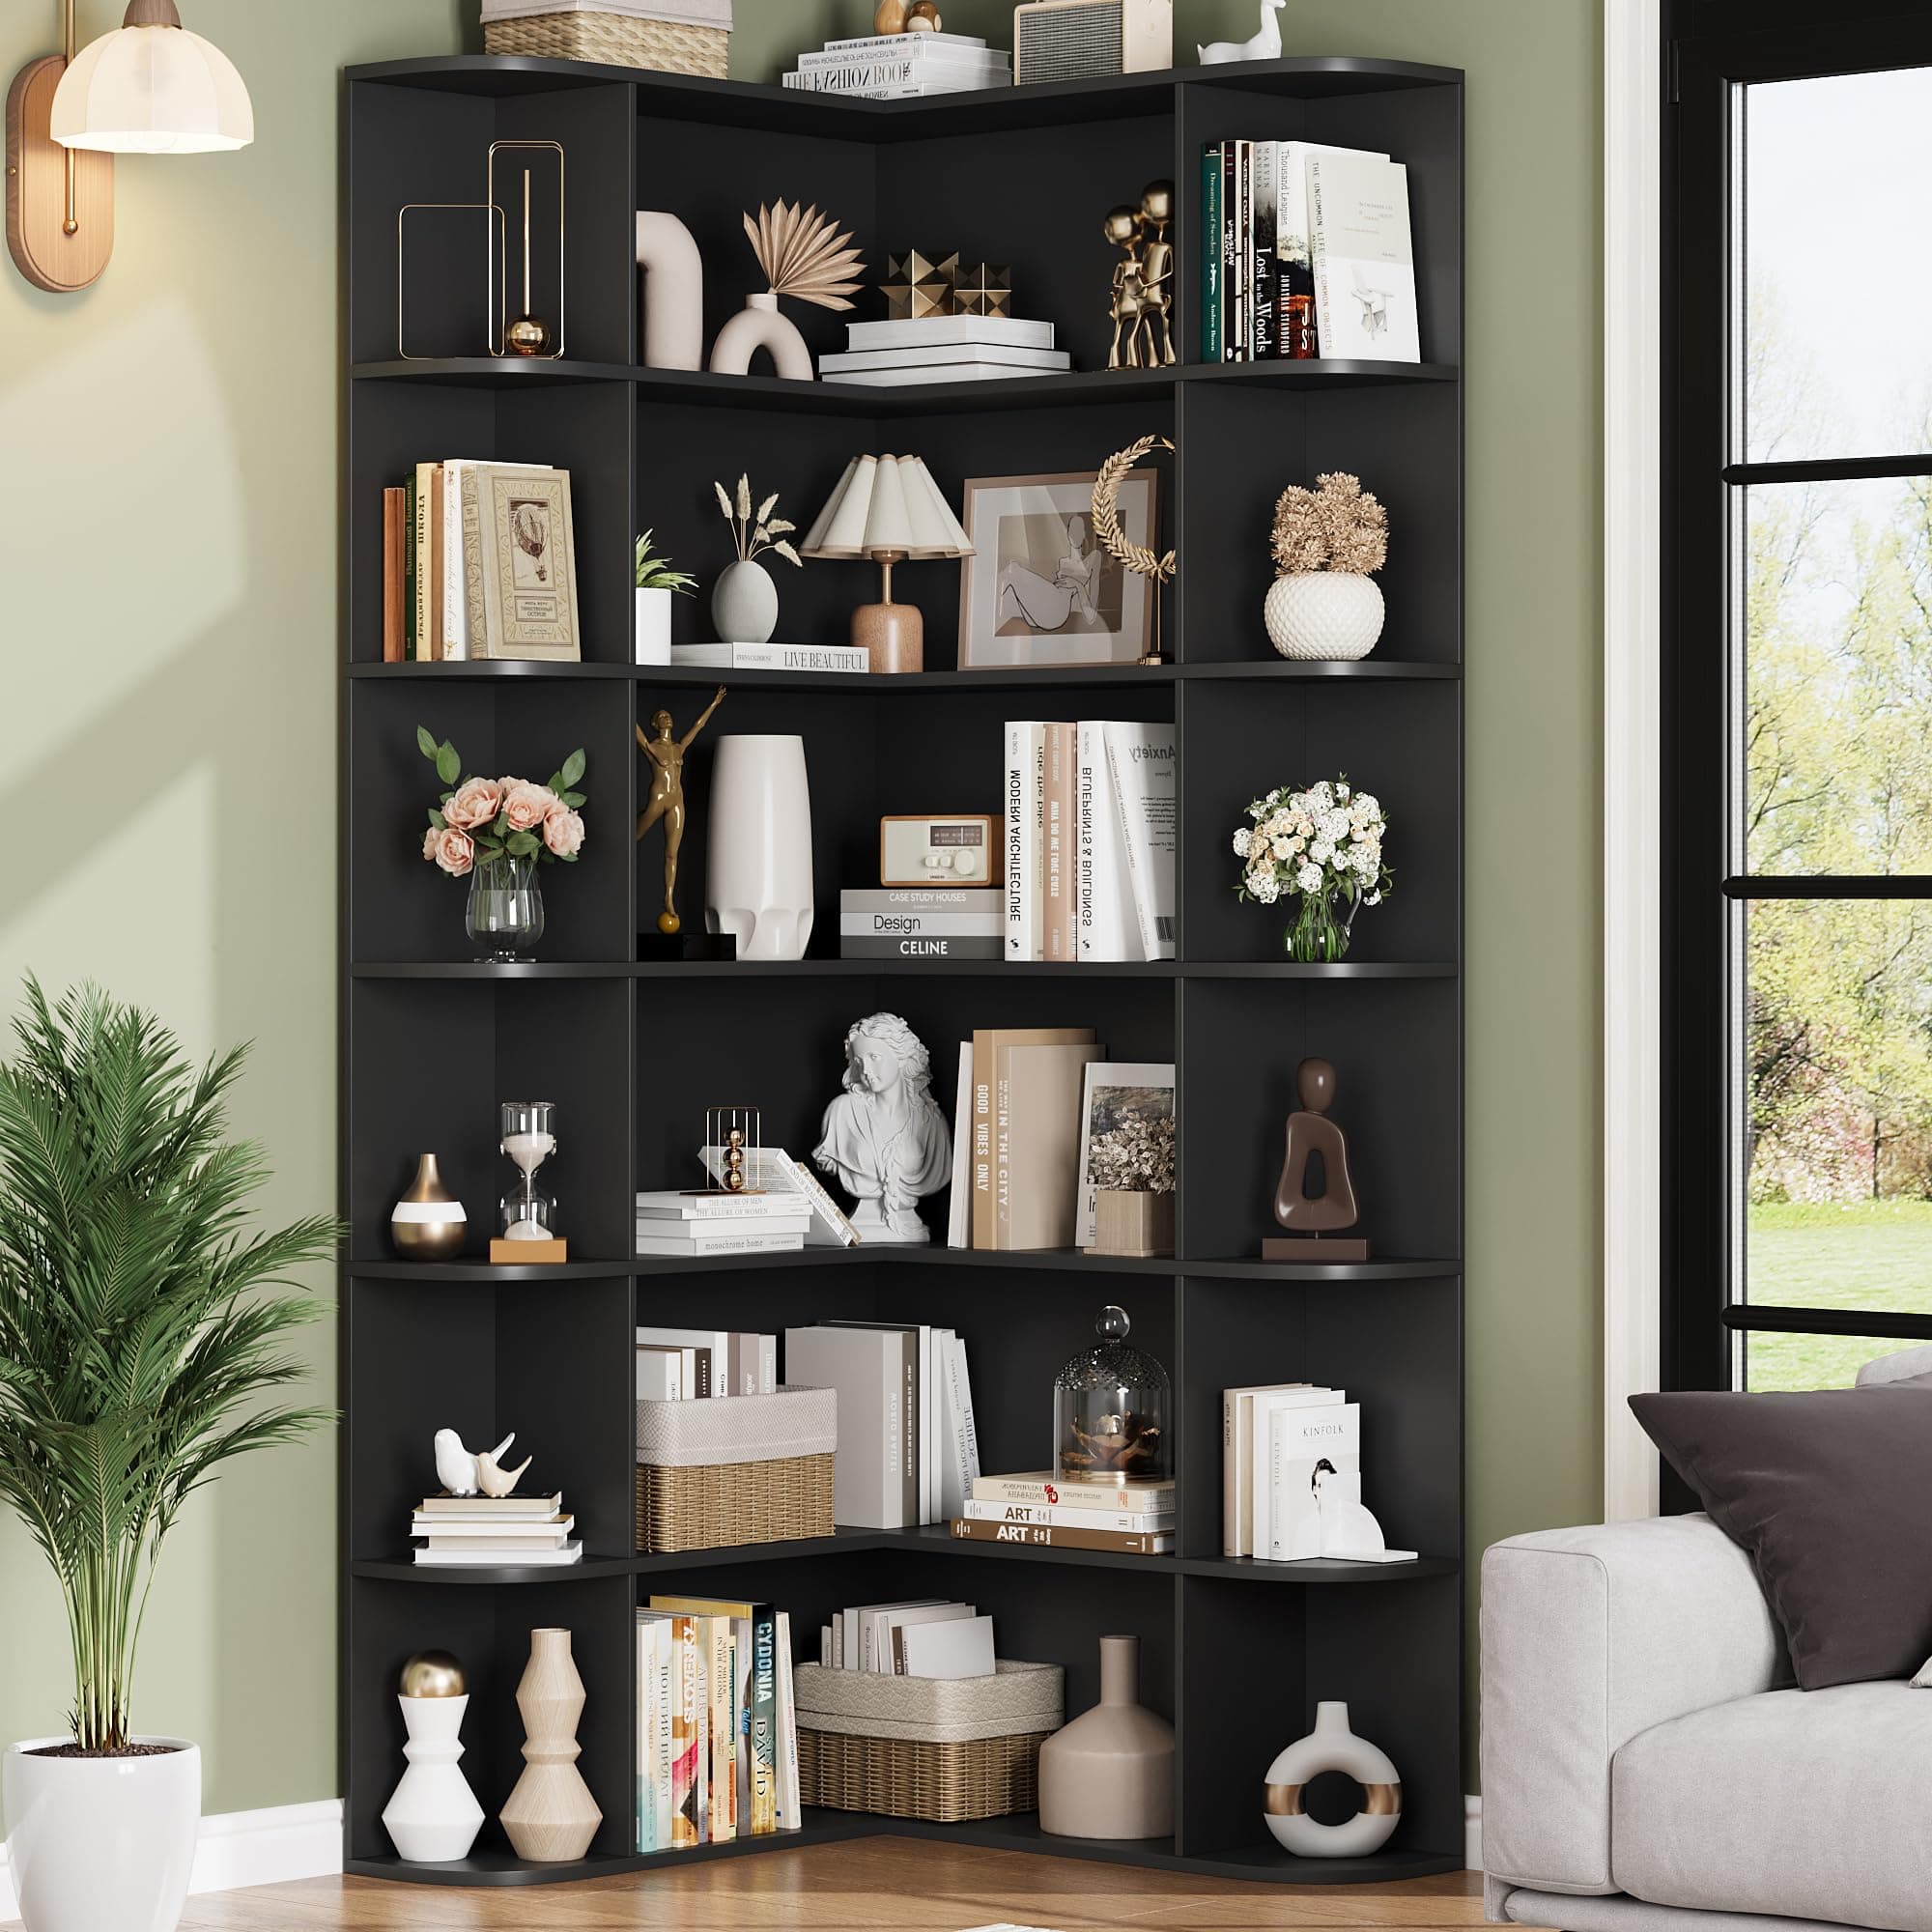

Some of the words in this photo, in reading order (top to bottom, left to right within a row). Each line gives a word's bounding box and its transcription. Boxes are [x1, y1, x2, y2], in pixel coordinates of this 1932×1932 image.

[1280, 150, 1290, 191] Thousand
[1312, 161, 1321, 178] THE
[1208, 172, 1217, 212] Dreaming
[1314, 183, 1323, 226] UNCOMMON
[1317, 232, 1325, 253] LIFE
[1256, 247, 1272, 280] Lost
[1320, 259, 1325, 269] OF
[1256, 283, 1263, 292] in
[1280, 274, 1290, 311] JONATHAN
[1321, 274, 1330, 307] COMMON
[1256, 301, 1272, 353] Woods
[1322, 312, 1333, 351] OBJECTS
[784, 651, 809, 668] LIVE
[810, 653, 866, 670] BEAUTIFUL
[889, 893, 909, 902] CASE
[911, 893, 934, 902] STUDY
[936, 893, 967, 902] HOUSES
[874, 915, 921, 934] Design
[899, 941, 949, 955] CELINE
[977, 1084, 989, 1114] GOOD
[999, 1110, 1008, 1126] IN
[977, 1122, 989, 1155] VIBES
[999, 1132, 1008, 1163] THE
[977, 1164, 989, 1191] ONLY
[999, 1170, 1008, 1207] CITY
[705, 1240, 745, 1251] monochrome
[746, 1239, 763, 1248] home
[1302, 1424, 1344, 1437] KINFOLK
[1005, 1507, 1032, 1520] ART
[997, 1525, 1028, 1542] ART
[756, 1622, 773, 1703] CYDONIA
[755, 1719, 766, 1797] DAVID
